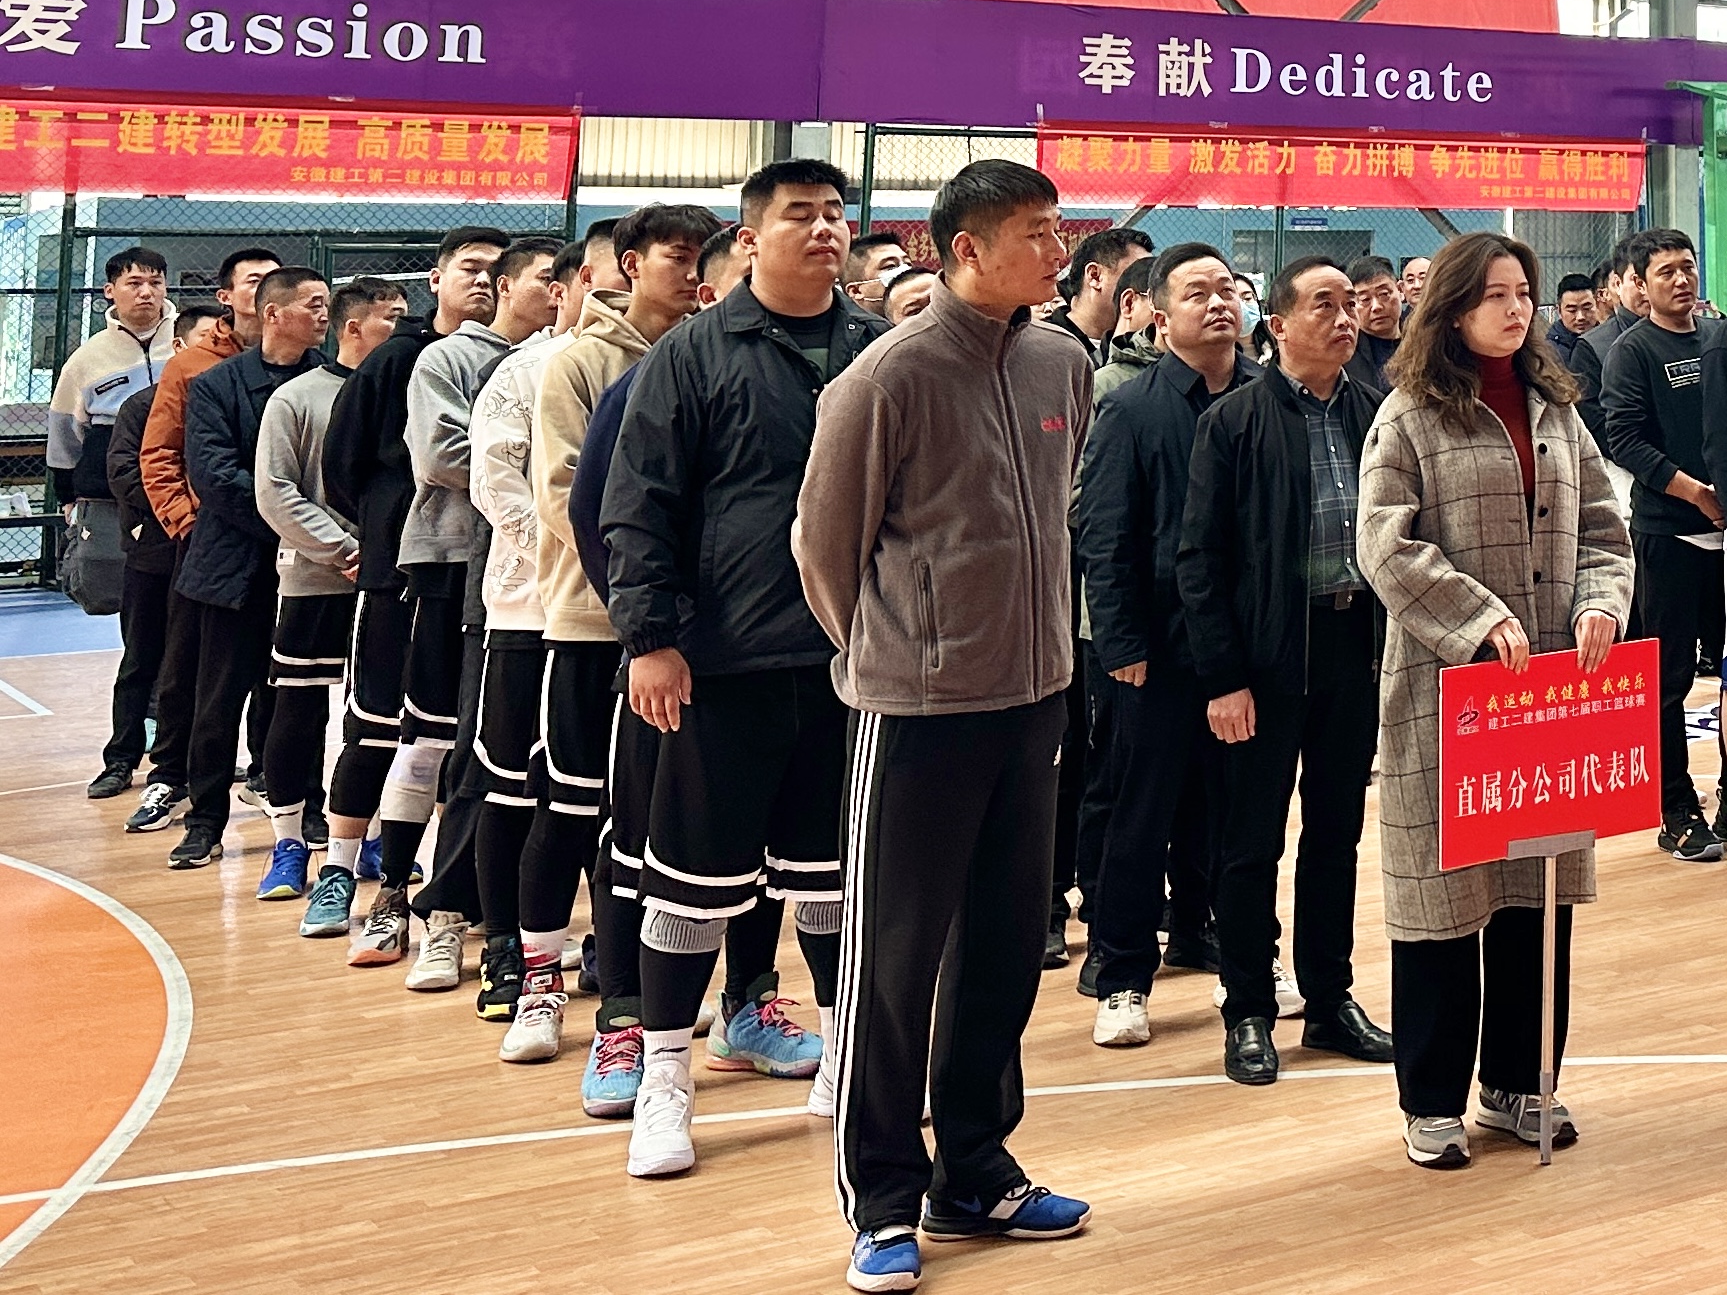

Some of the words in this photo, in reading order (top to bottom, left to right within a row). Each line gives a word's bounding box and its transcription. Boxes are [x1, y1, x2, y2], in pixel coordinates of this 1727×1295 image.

[1078, 34, 1213, 99] 奉献
[1230, 46, 1495, 103] Dedicate
[356, 116, 550, 165] 高质量发展
[1055, 135, 1173, 173] 凝聚力量
[1189, 138, 1296, 176] 激发活力
[1314, 142, 1415, 178] 奋力拼搏
[1428, 143, 1525, 181] 争先进位
[1538, 148, 1630, 183] 赢得胜利
[290, 166, 548, 187] 安徽建工第二建设集团有限公司
[1486, 690, 1535, 714] 我运动
[1544, 679, 1590, 704] 我健康
[1600, 671, 1646, 695] 我快乐
[1488, 693, 1647, 731] 建工二建集团第七届职工篮球赛
[1454, 745, 1651, 819] 直属分公司代表队
